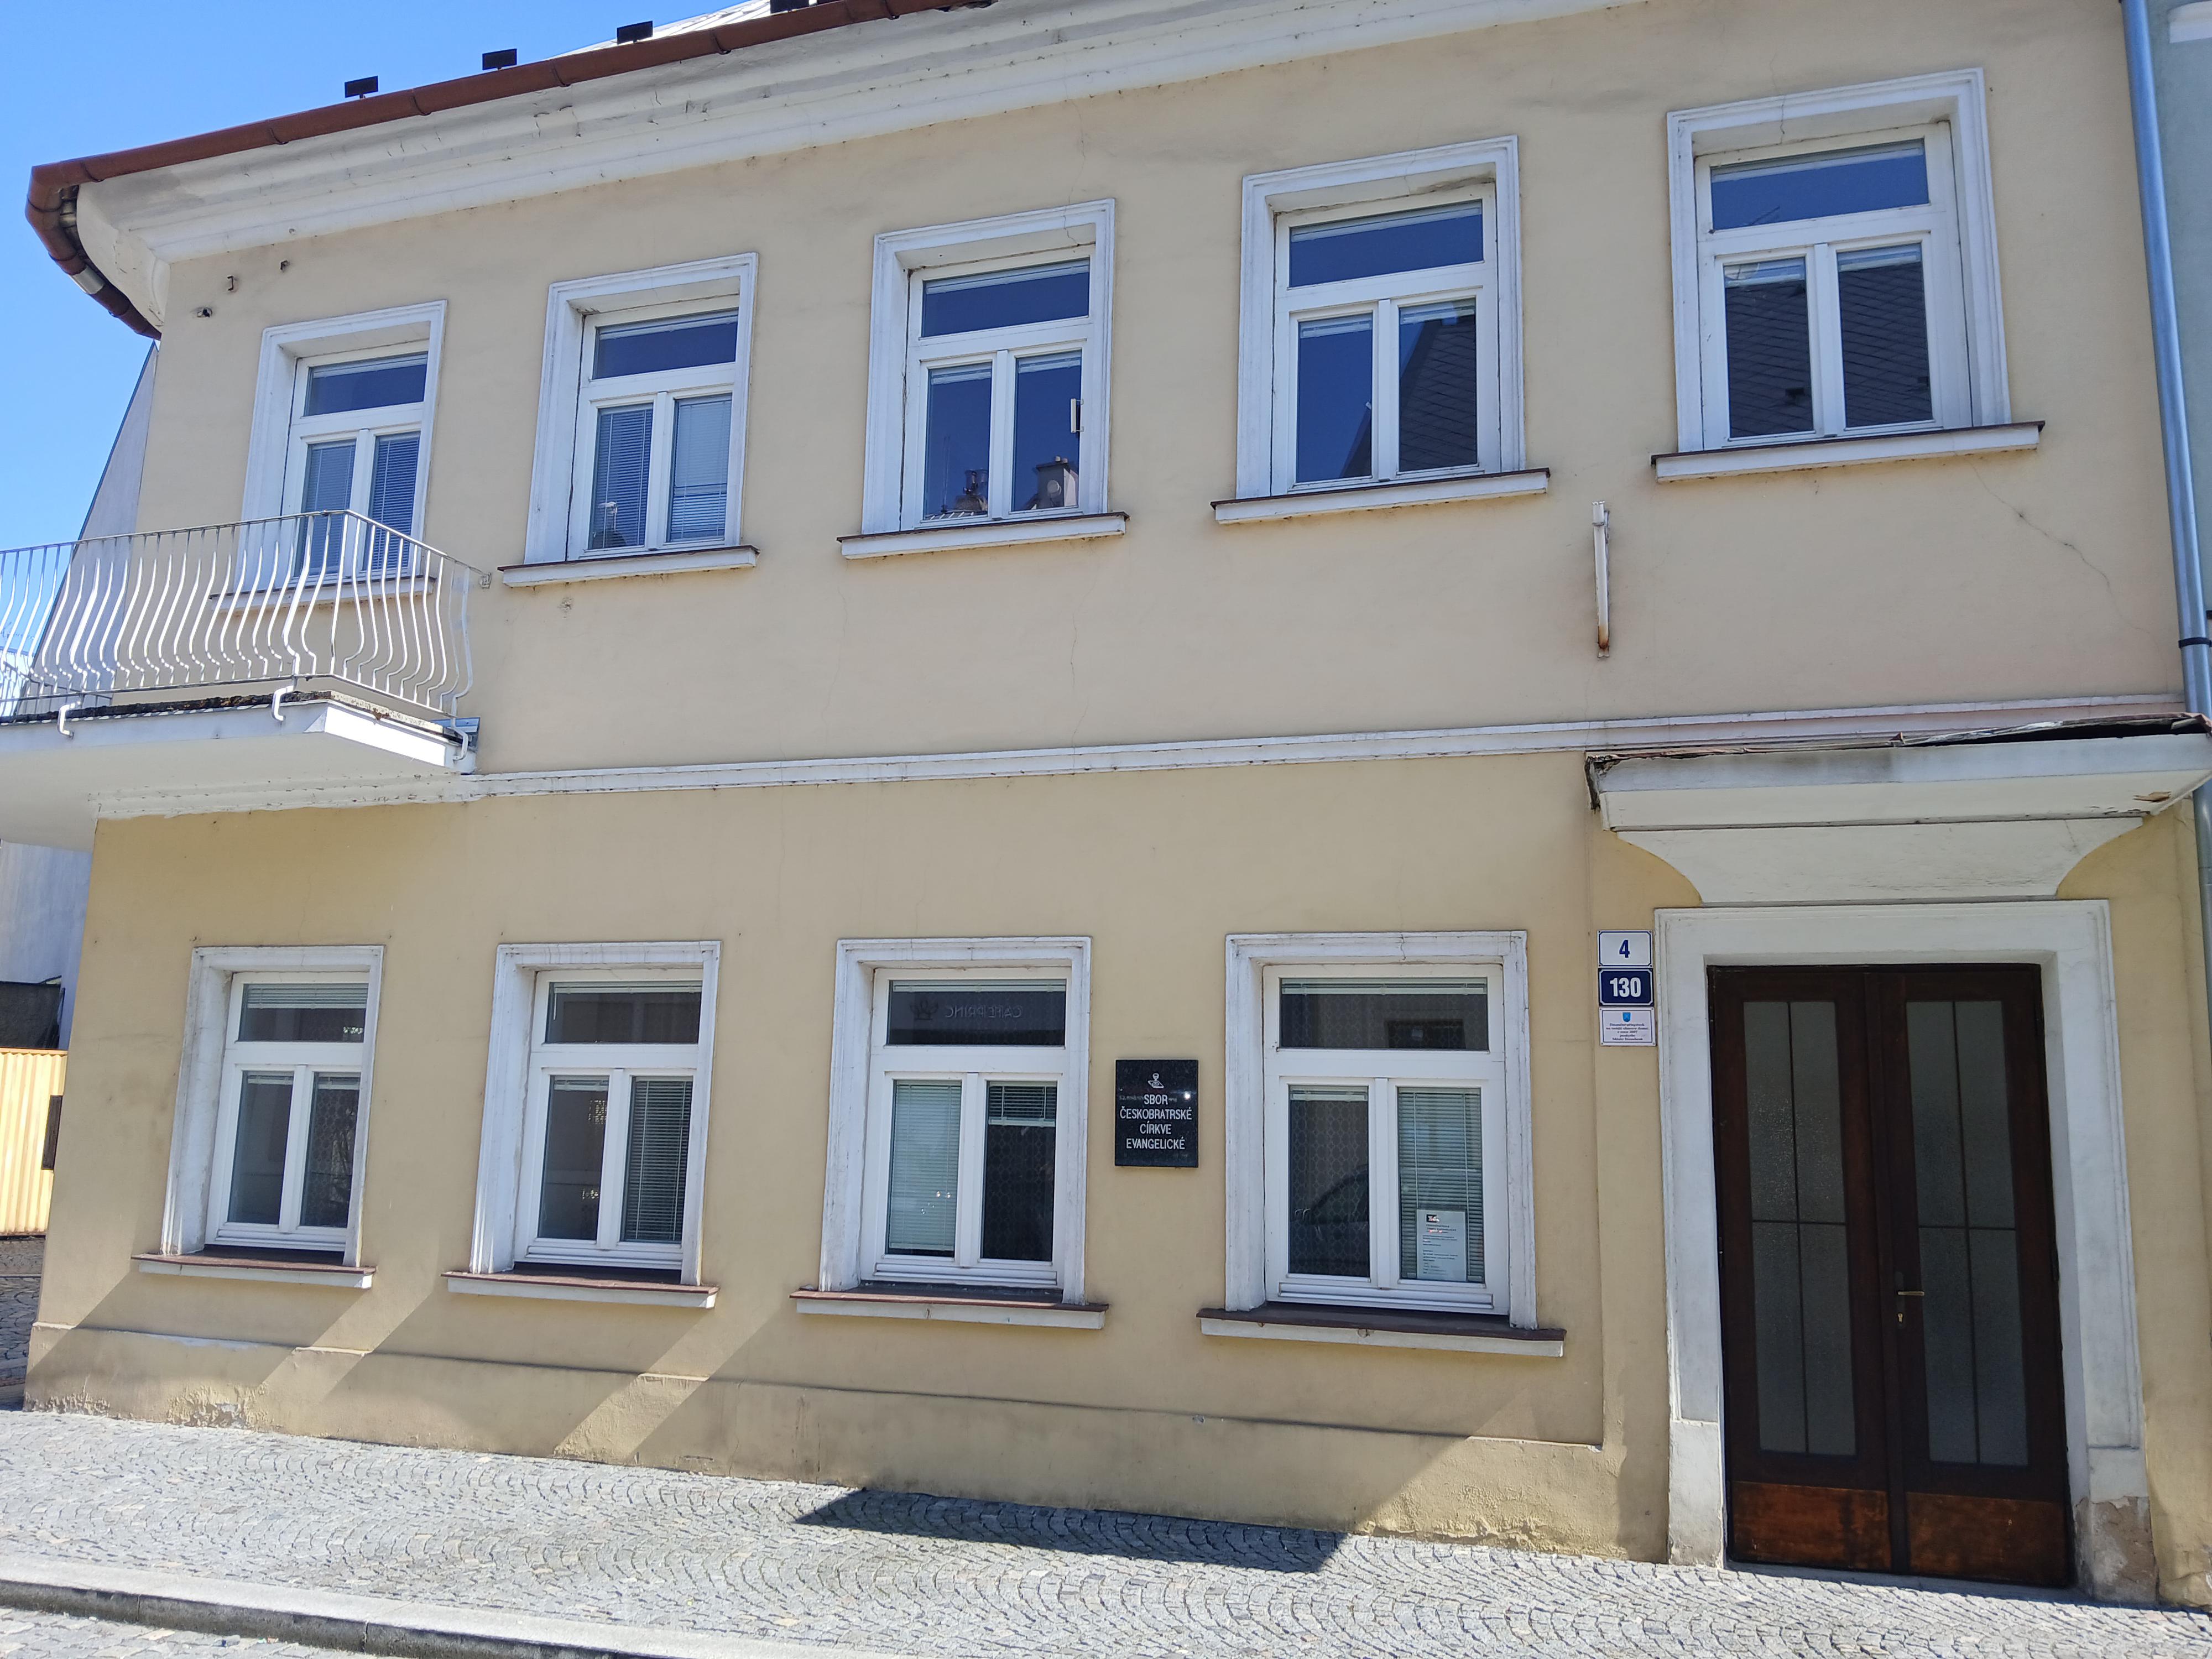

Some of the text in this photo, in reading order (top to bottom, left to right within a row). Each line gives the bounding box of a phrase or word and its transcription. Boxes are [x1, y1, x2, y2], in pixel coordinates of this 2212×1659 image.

[1619, 940, 1630, 958] 4
[1610, 977, 1641, 997] 130
[1144, 1094, 1168, 1105] SBOR
[1120, 1106, 1192, 1120] ČESKOBRATRSKÉ
[1140, 1120, 1172, 1134] CÍRKVE
[1126, 1136, 1186, 1149] EVANGELICKÉ
